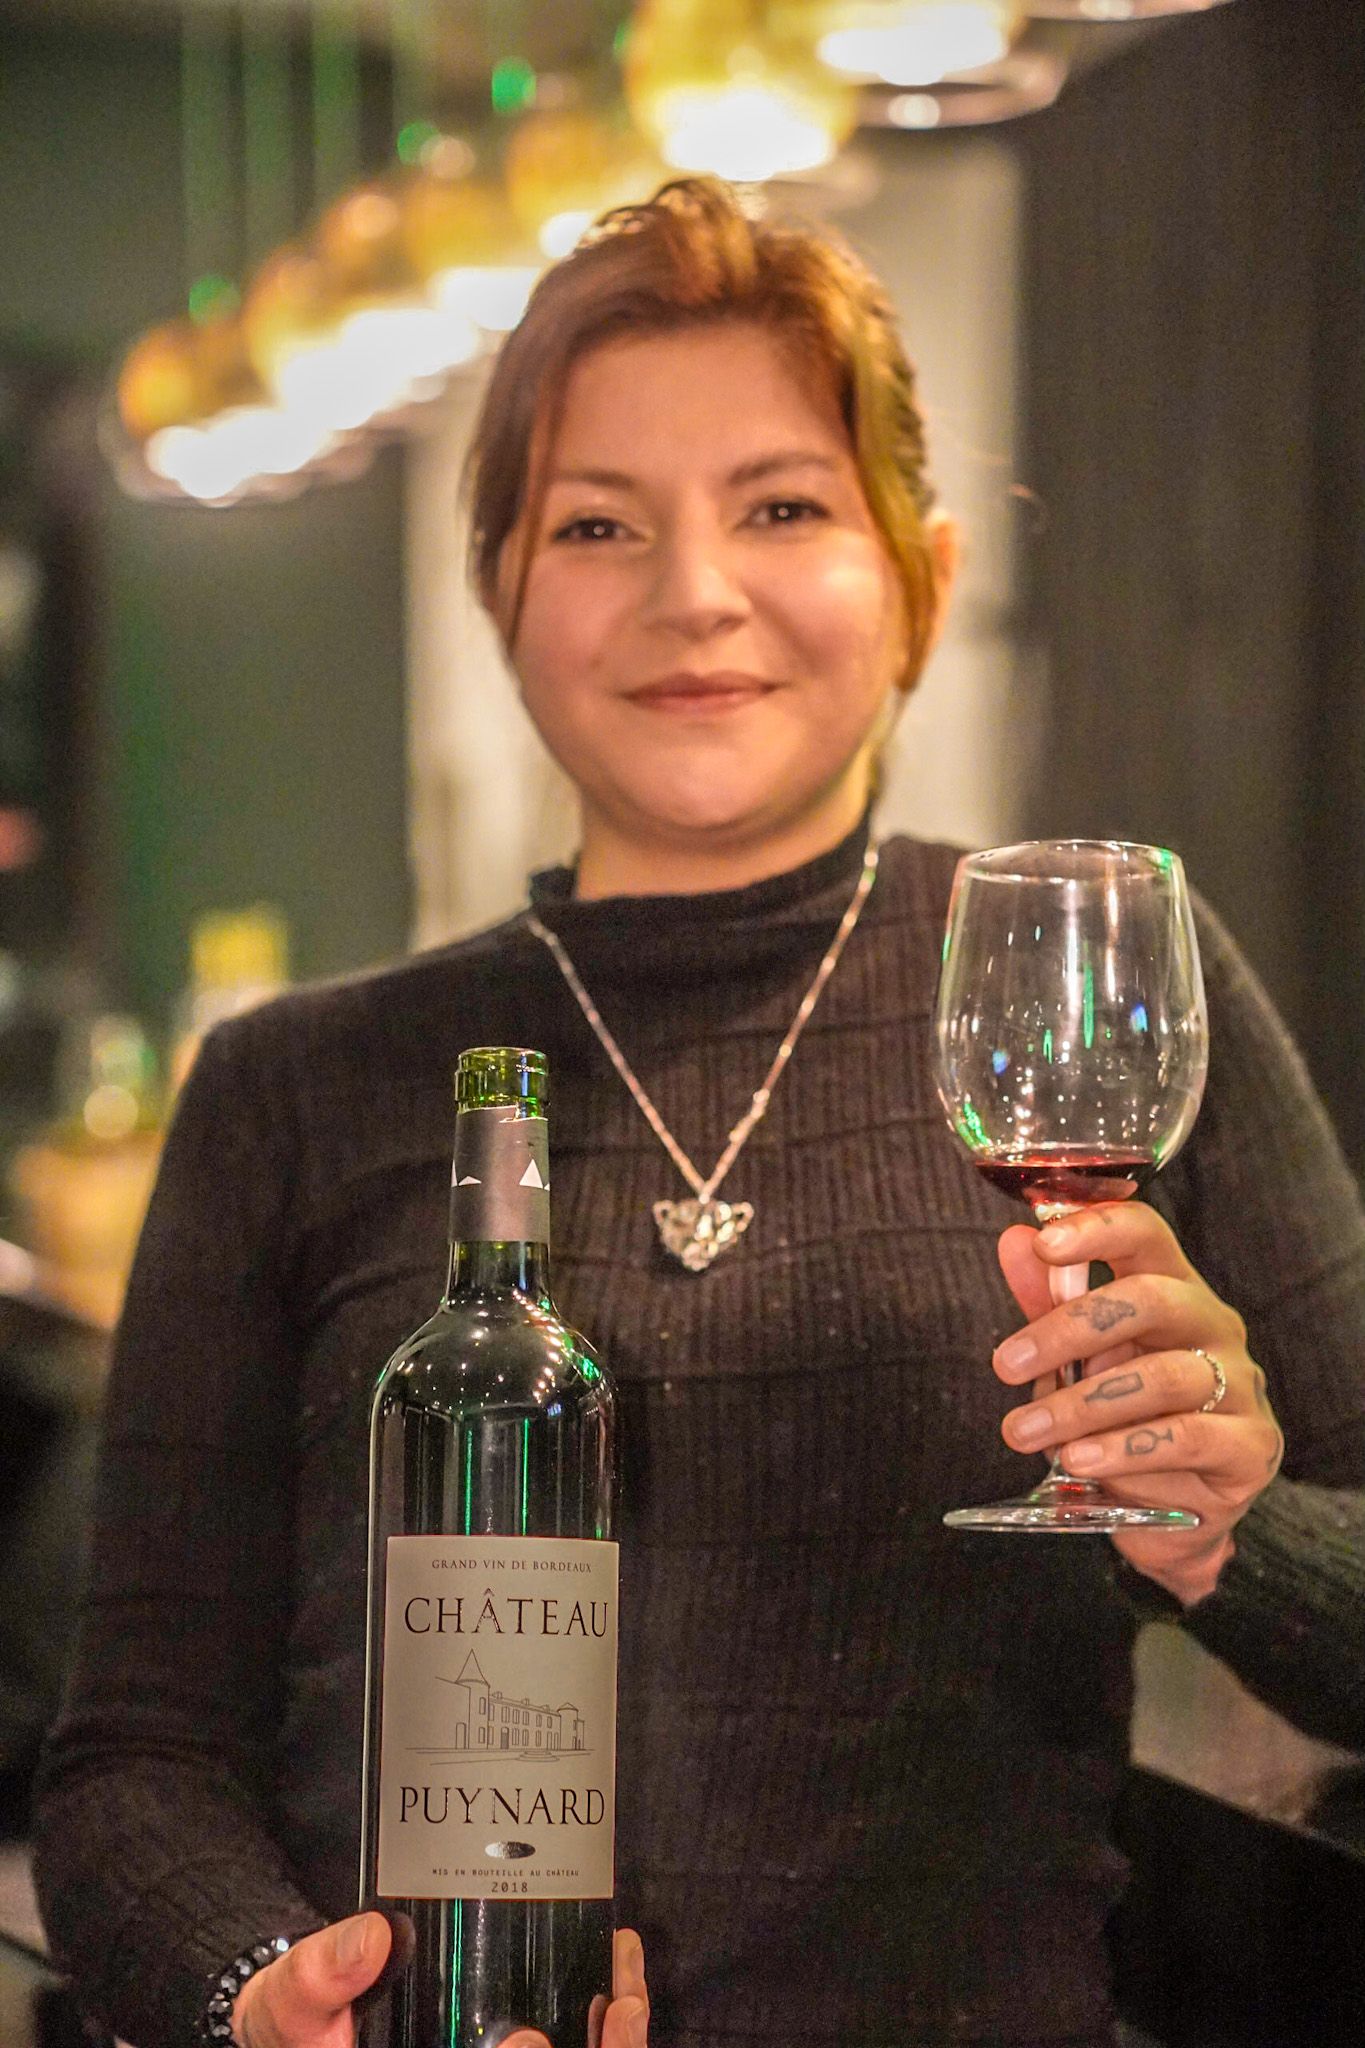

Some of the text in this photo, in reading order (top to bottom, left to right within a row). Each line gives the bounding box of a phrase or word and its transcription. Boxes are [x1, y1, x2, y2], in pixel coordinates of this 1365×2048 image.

[432, 1559, 592, 1573] GRAND VIN DE BORDEAUX
[404, 1587, 608, 1637] CHÂTEAU
[400, 1786, 605, 1825] PUYNARD
[546, 1868, 579, 1877] CHÂTEAU
[491, 1882, 529, 1893] 2018
